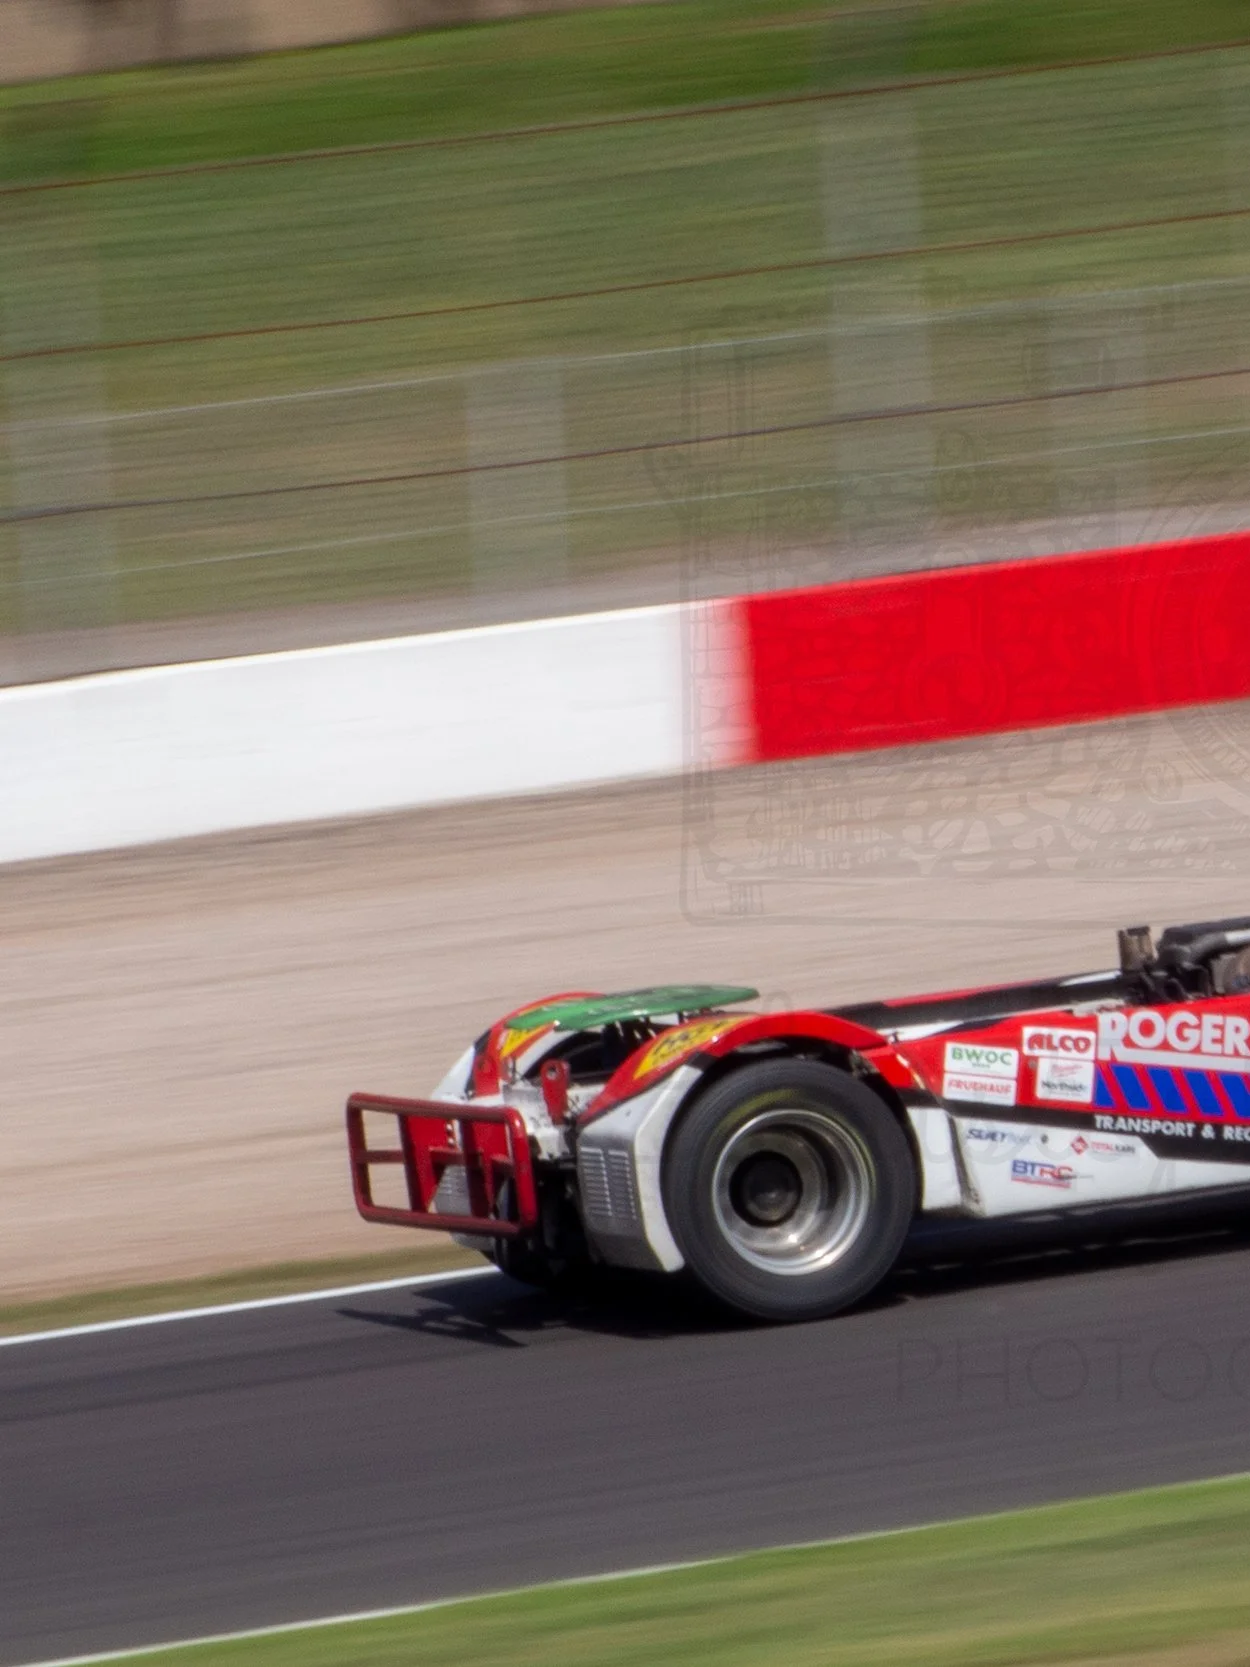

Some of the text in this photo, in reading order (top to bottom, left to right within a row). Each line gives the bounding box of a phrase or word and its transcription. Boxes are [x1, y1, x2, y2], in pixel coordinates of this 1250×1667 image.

[1027, 1033, 1092, 1054] ALCO
[1096, 1010, 1250, 1060] ROGER
[952, 1047, 1012, 1066] BWOC
[1094, 1114, 1196, 1138] TRANSPORT
[1201, 1123, 1216, 1140] &
[1011, 1159, 1073, 1179] BTRC
